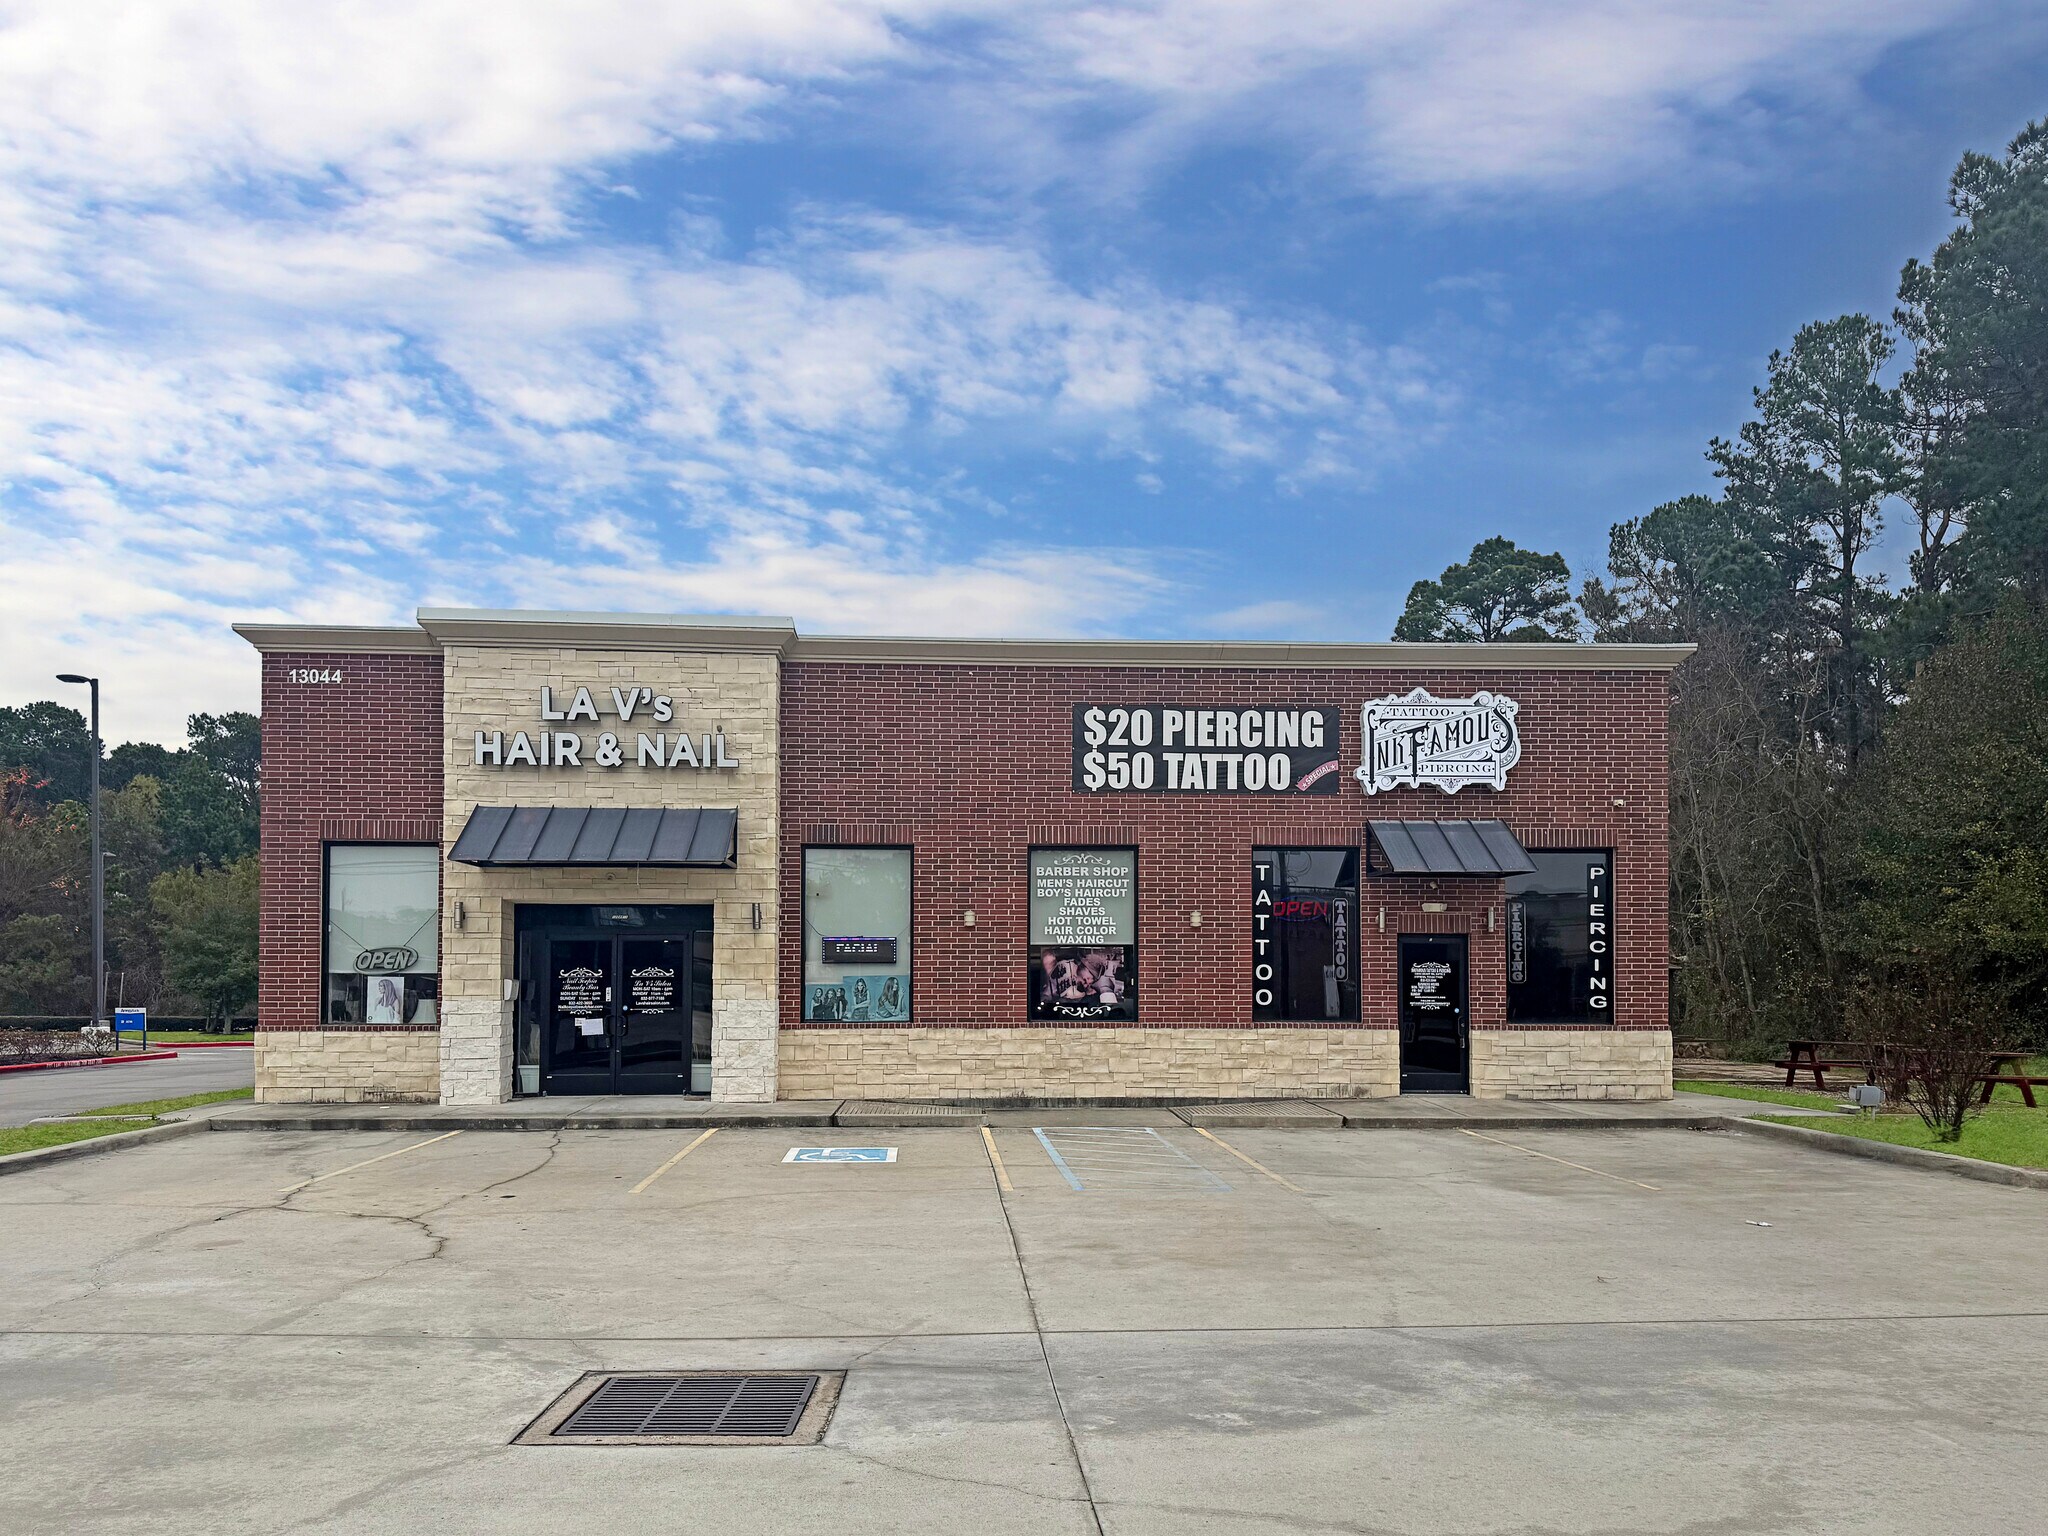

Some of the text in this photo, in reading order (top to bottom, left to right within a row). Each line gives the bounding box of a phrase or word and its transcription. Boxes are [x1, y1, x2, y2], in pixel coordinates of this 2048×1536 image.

[289, 669, 342, 684] 13044
[540, 686, 673, 722] LA V's
[1389, 707, 1450, 717] TATTOO
[1083, 706, 1324, 749] $20 PIERCING
[474, 731, 739, 768] HAIR & NAIL
[1083, 749, 1291, 791] $50 TATTOO
[1305, 765, 1331, 785] SPECIAL
[1420, 764, 1492, 773] PIERCING
[1036, 866, 1129, 877] BARBER SHOP
[1037, 879, 1129, 888] MEN'S HAIRCUT
[1037, 888, 1127, 897] BOY'S HAIRCUT
[1064, 898, 1101, 906] FADES
[1273, 901, 1328, 917] OPEN
[1059, 907, 1105, 916] SHAVES
[1048, 917, 1116, 925] HOT TOWEL
[1044, 926, 1117, 935] HAIR COLOR
[1255, 864, 1273, 1006] TATTOO
[1589, 867, 1608, 1009] PIERCING
[1056, 935, 1104, 944] WAXING
[1334, 900, 1347, 979] TATTOO
[1511, 902, 1523, 981] PIERCING
[356, 950, 411, 970] OPEN
